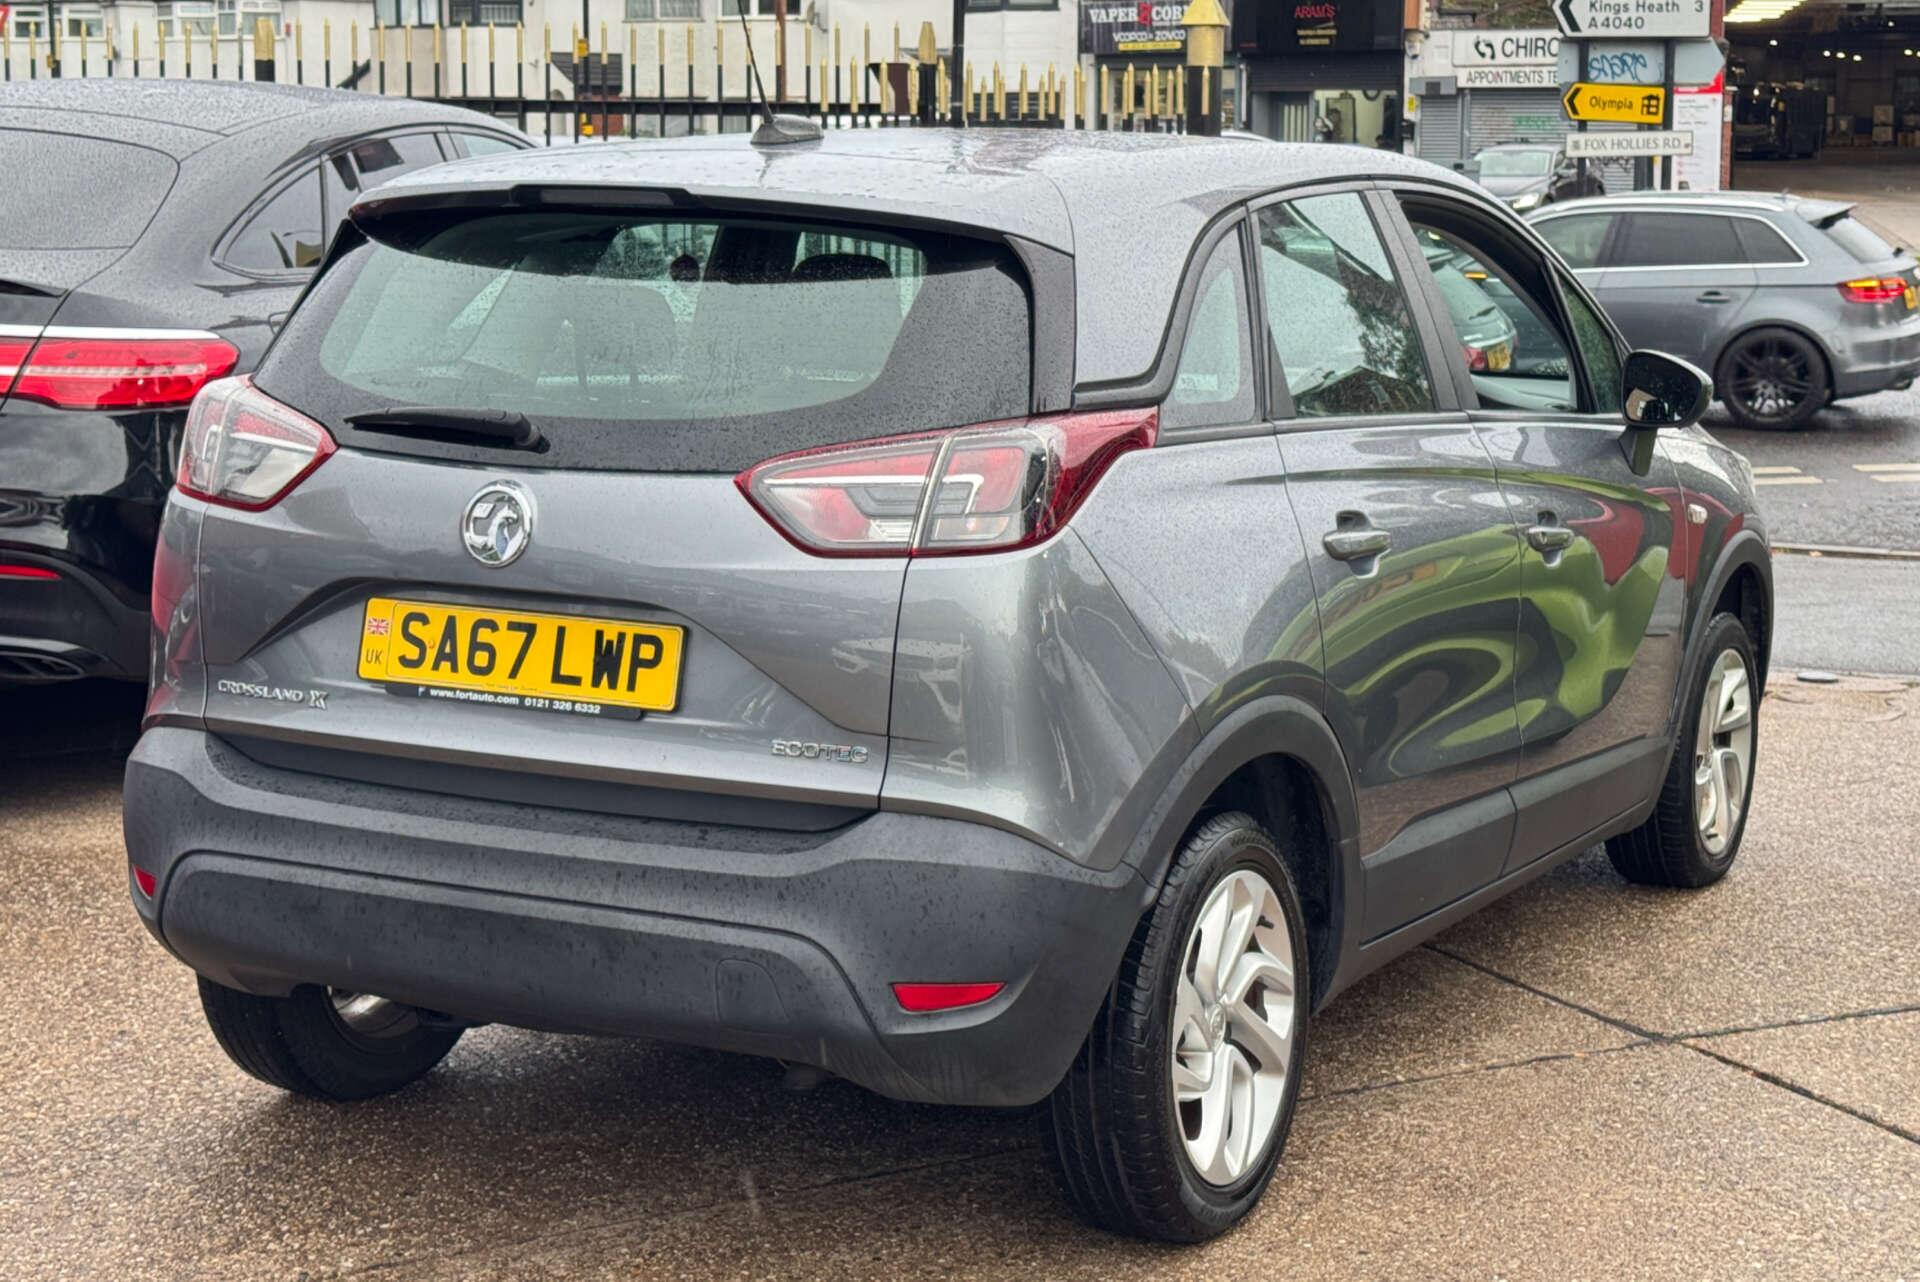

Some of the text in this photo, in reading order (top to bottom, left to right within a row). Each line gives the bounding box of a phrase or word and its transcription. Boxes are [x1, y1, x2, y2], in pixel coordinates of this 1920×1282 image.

[1589, 0, 1704, 14] Kings Heath 3
[1588, 16, 1645, 29] A4040
[1466, 69, 1544, 84] APPOINTMENTS
[1589, 96, 1633, 110] Olympia
[1584, 139, 1607, 151] FOX
[1610, 137, 1659, 151] HOLLIES
[365, 648, 383, 665] UK
[397, 611, 664, 692] SA67 LWP
[218, 680, 303, 702] CROSSLAND
[430, 687, 519, 705] www.fortauto.com
[524, 699, 549, 709] 0121
[552, 702, 572, 712] 326
[575, 705, 601, 714] 6332
[771, 739, 868, 763] ECOTEC
